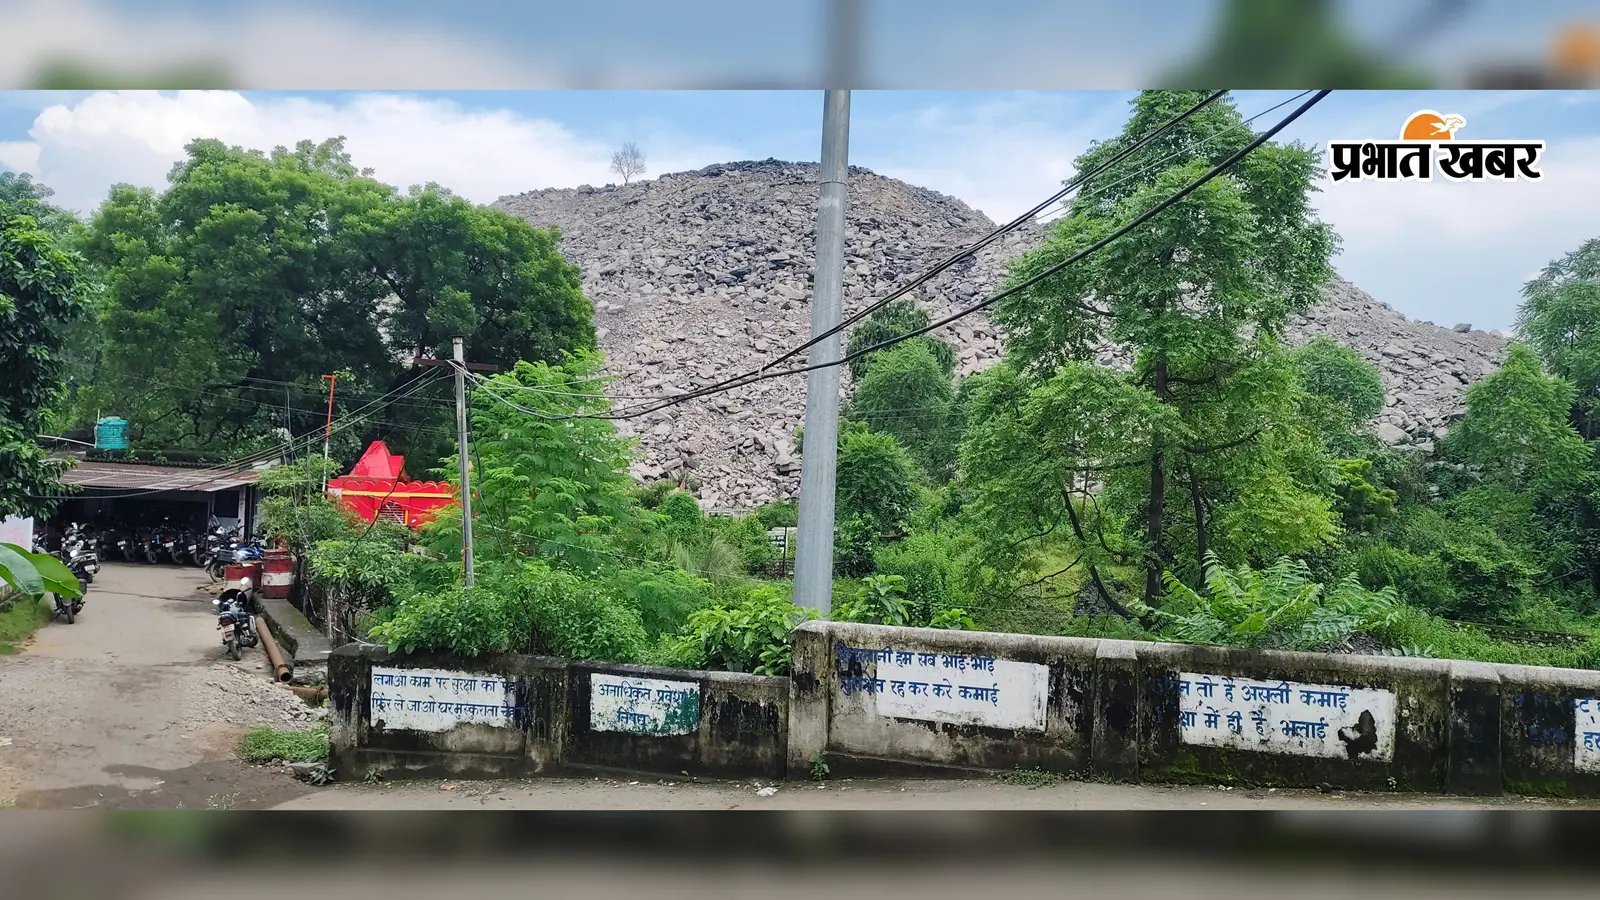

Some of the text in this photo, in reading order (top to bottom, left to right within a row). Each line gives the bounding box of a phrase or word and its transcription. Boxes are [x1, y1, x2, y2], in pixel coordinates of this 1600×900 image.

[896, 651, 914, 667] हम
[918, 653, 937, 667] सब
[410, 675, 432, 688] काम
[434, 677, 450, 690] पर
[452, 678, 478, 695] सुरक्षा
[890, 680, 906, 698] रह
[908, 681, 929, 697] कर
[932, 678, 953, 699] करे
[958, 682, 1000, 707] कमाई
[1194, 675, 1219, 698] तो
[1221, 676, 1236, 702] है
[1299, 686, 1350, 714] कमाई
[394, 693, 406, 711] ले
[406, 694, 437, 713] जाओ
[438, 701, 454, 715] घर
[1203, 705, 1221, 730] में
[1280, 716, 1330, 745] भलाई
